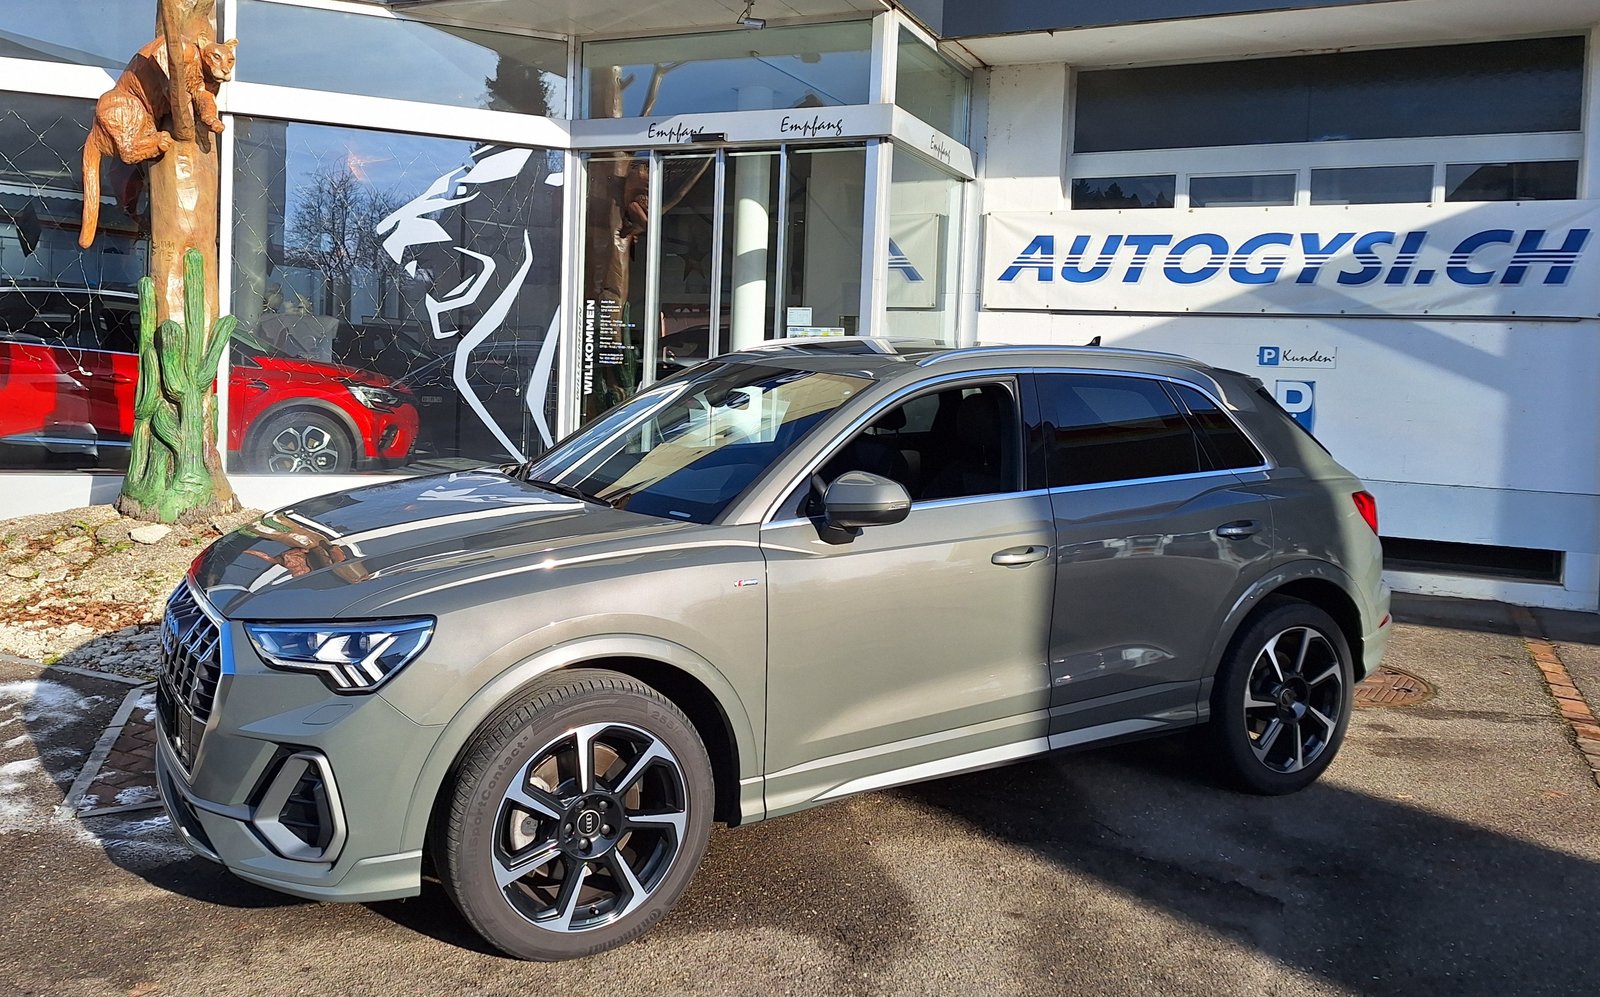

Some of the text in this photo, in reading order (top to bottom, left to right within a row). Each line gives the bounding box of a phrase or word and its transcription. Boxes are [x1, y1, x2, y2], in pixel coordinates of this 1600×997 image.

[780, 115, 843, 137] Empfang
[930, 134, 951, 164] Empfang
[997, 228, 1592, 286] AUTOGYSI.CH
[583, 299, 596, 395] WILLKOMMEN
[1263, 348, 1332, 364] P Kunden
